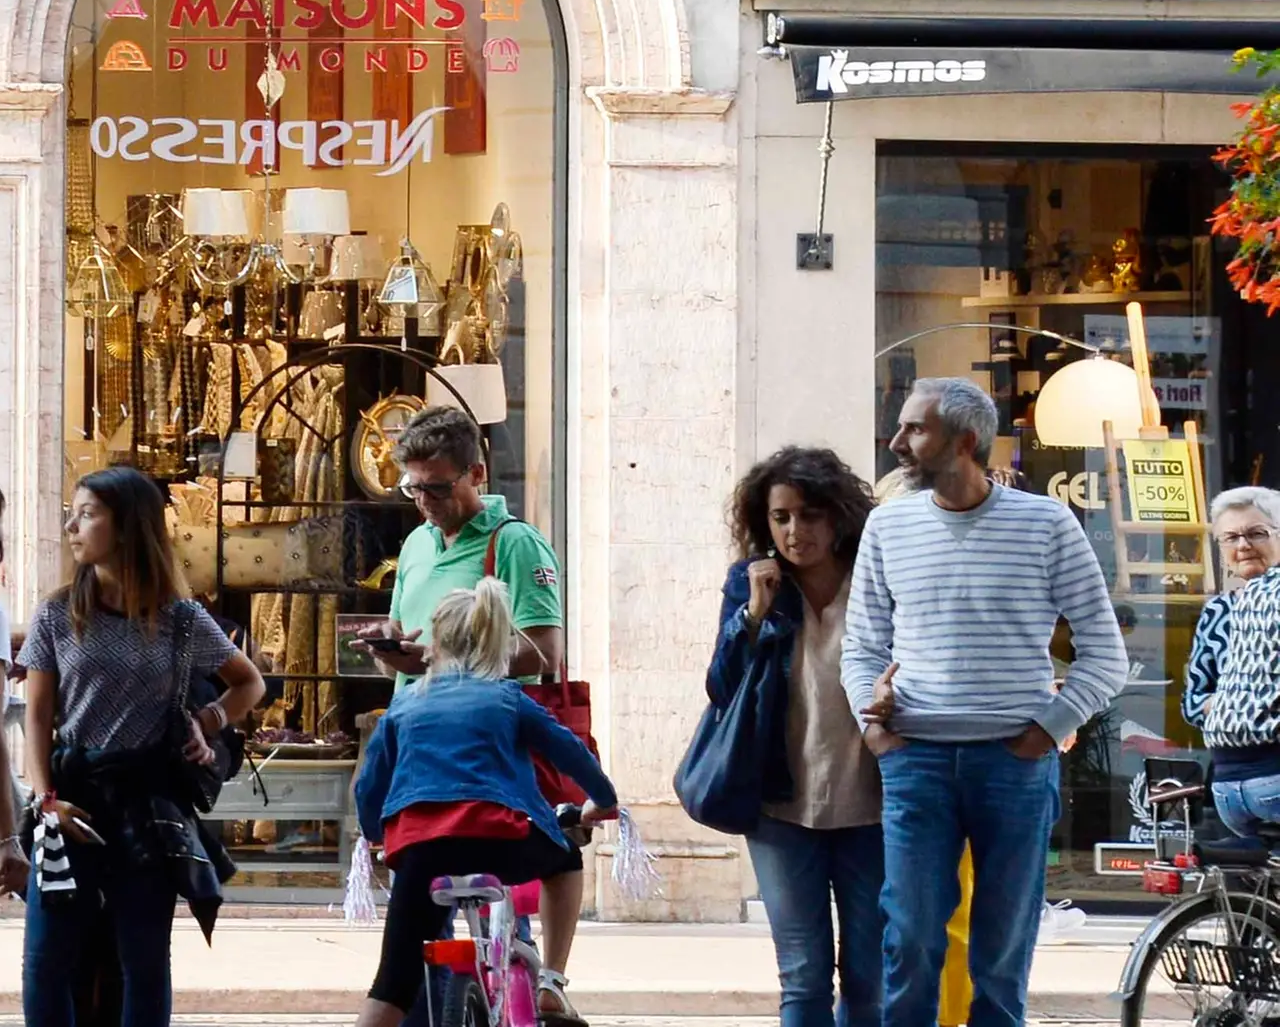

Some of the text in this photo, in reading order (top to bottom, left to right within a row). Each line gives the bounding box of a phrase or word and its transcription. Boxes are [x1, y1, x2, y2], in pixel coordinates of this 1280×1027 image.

[167, 46, 464, 74] DU MONDE
[1134, 462, 1183, 474] TUTTO
[1138, 485, 1185, 501] -50%
